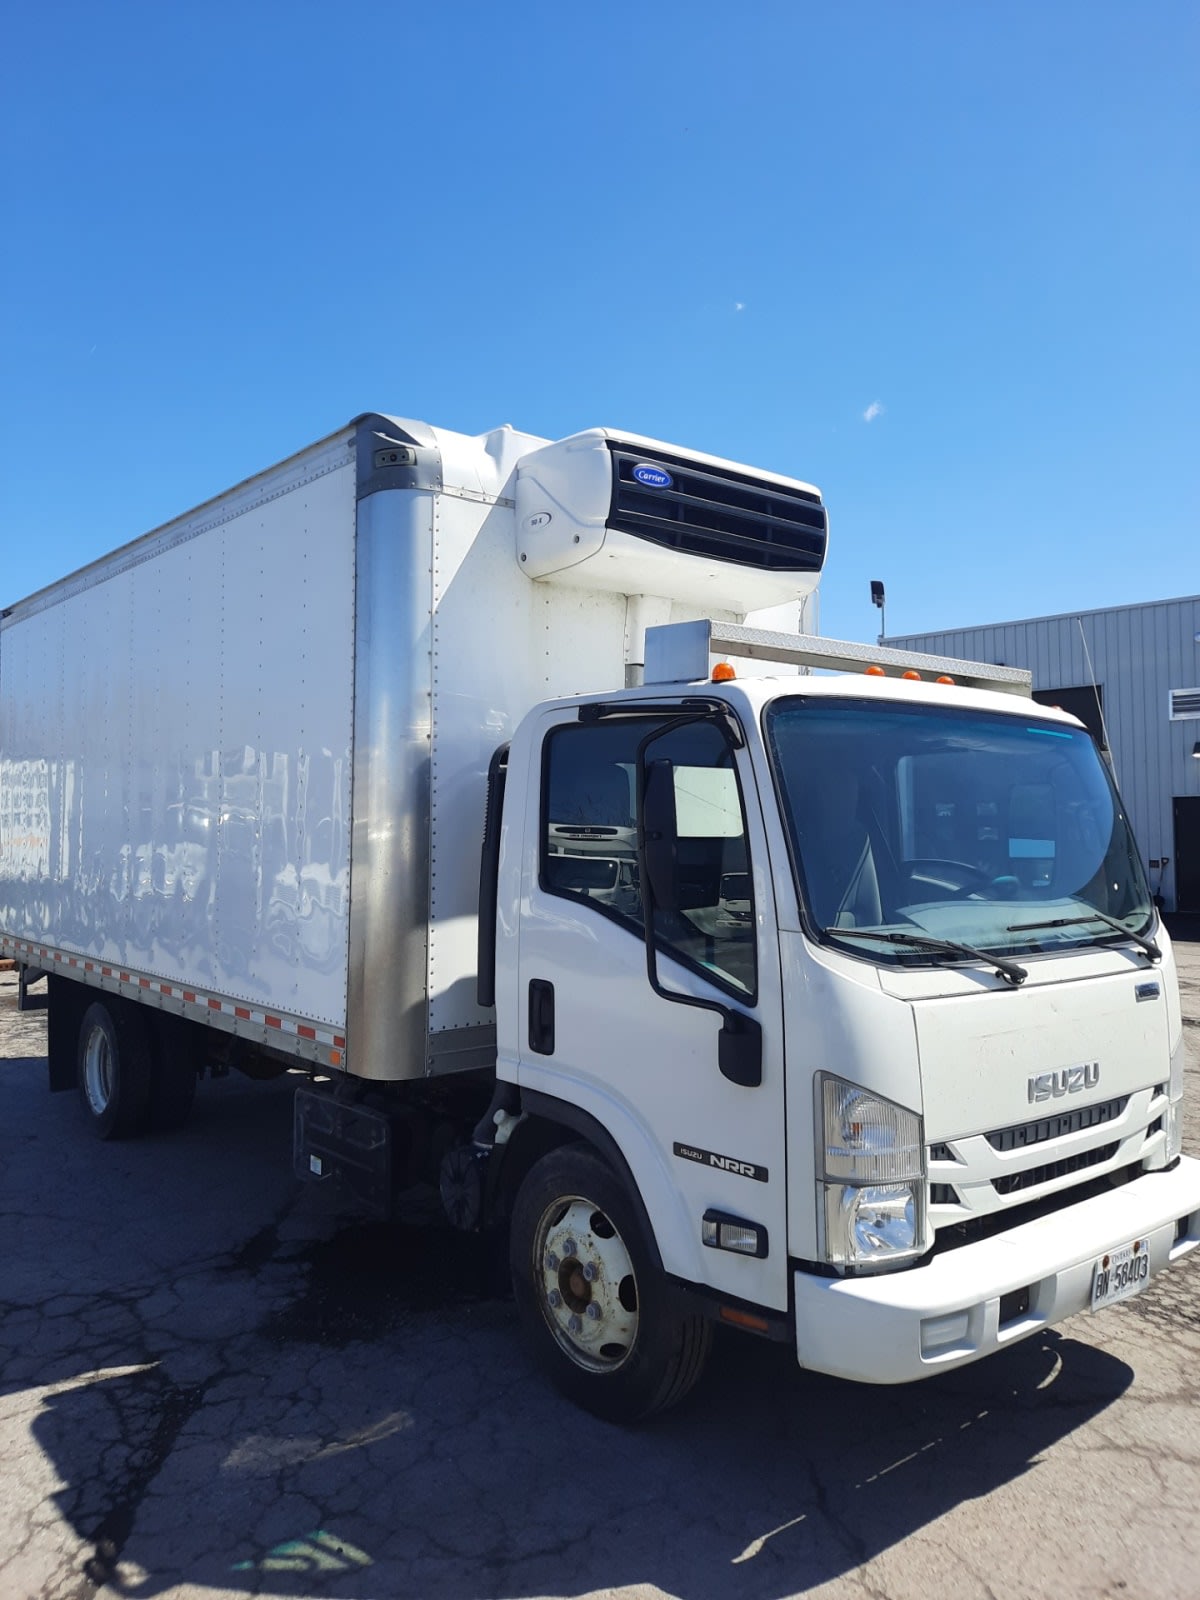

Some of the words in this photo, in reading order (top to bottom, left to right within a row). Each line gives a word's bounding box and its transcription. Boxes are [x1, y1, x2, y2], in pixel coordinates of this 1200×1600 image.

[638, 470, 666, 483] Carrier
[1028, 1062, 1099, 1103] ISUZU
[680, 1148, 702, 1159] ISUZU
[710, 1155, 755, 1177] NRR
